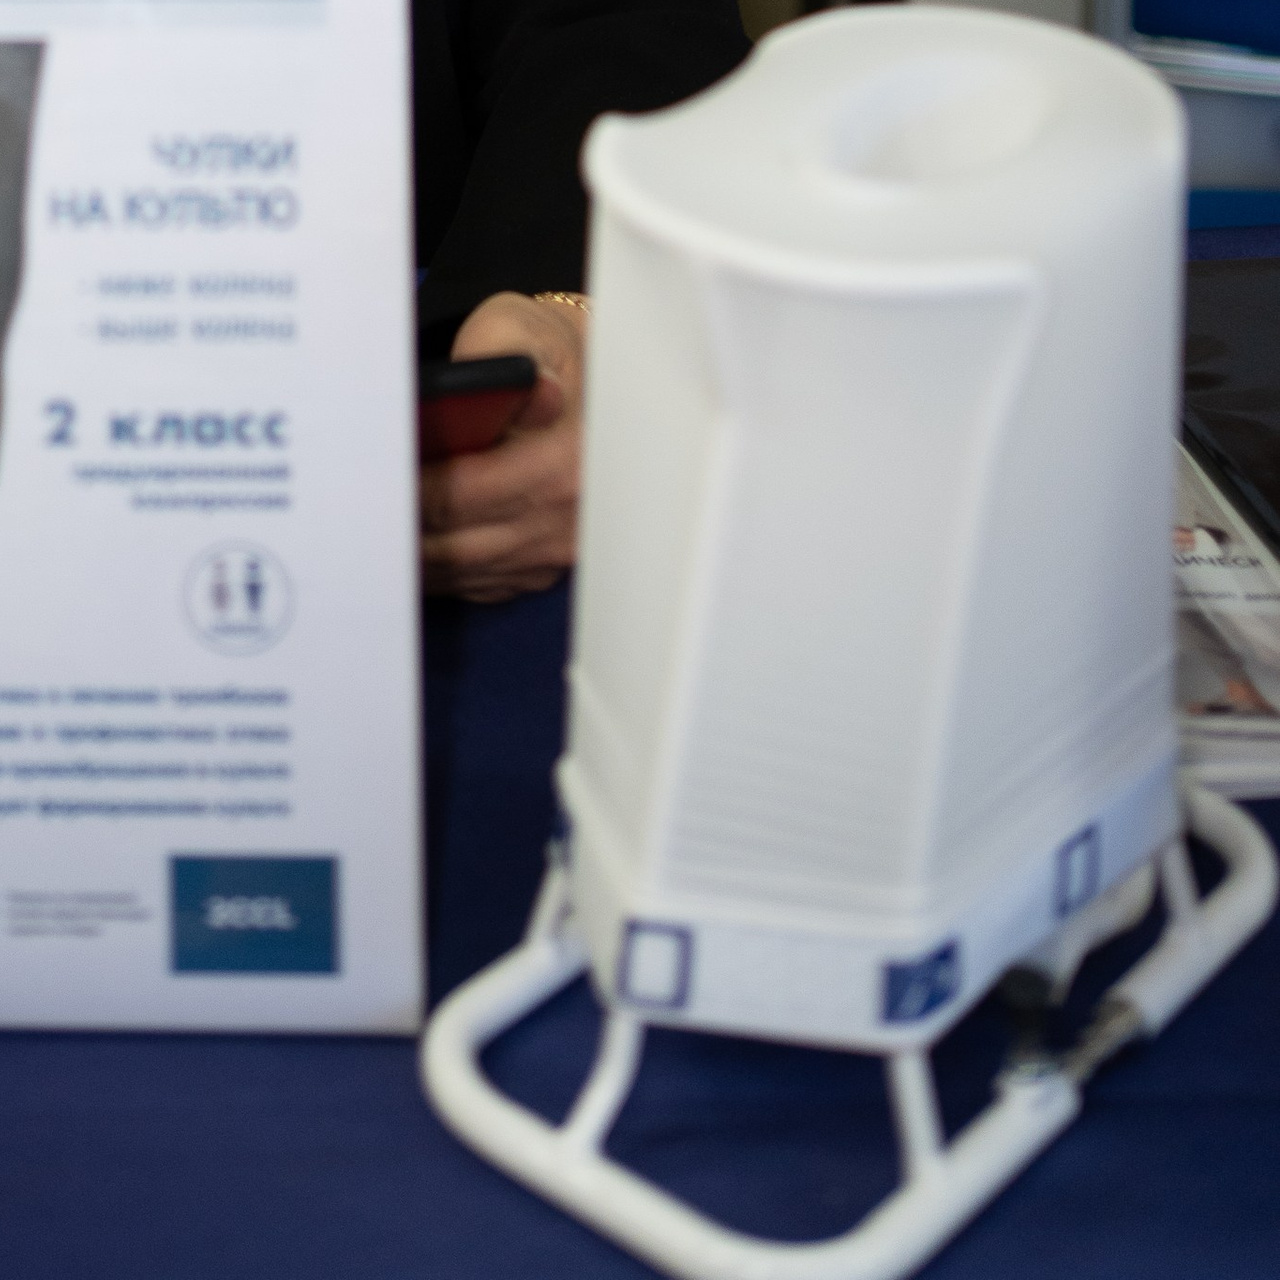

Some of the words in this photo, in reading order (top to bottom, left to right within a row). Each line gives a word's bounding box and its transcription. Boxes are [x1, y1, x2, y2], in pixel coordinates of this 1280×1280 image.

[48, 187, 112, 228] НА
[42, 397, 77, 448] 2
[107, 410, 290, 448] класс
